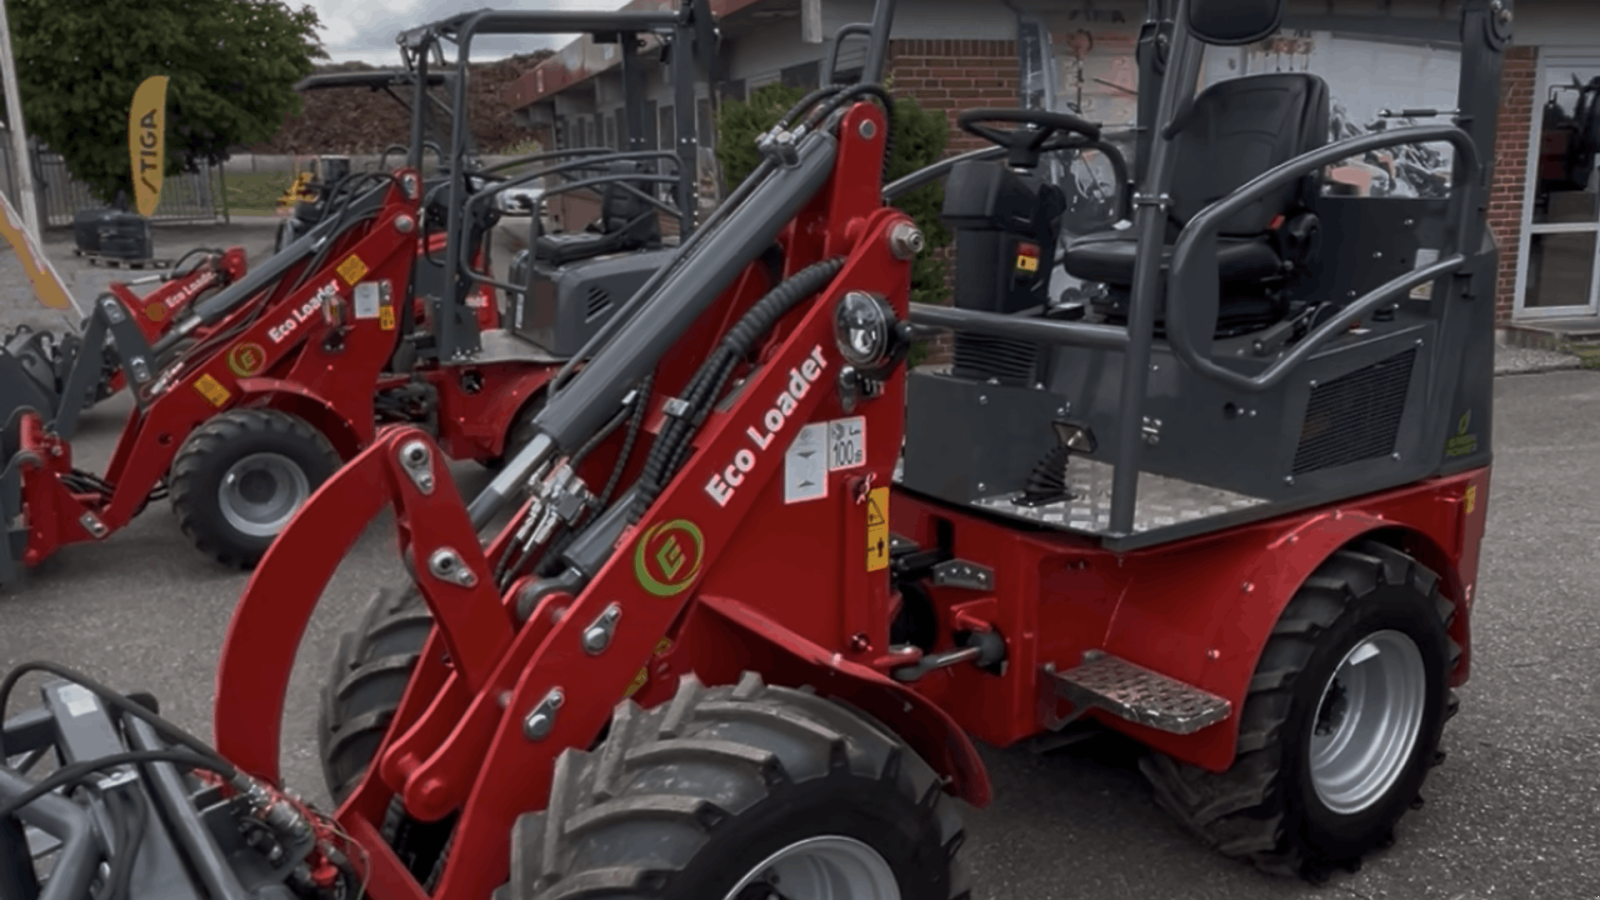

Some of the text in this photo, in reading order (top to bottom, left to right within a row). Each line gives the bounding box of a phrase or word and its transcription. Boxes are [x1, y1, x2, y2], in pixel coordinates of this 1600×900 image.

[140, 108, 158, 194] STIGA
[267, 279, 340, 344] Eco Loader
[705, 344, 828, 508] Eco Loader
[833, 439, 854, 466] 100
